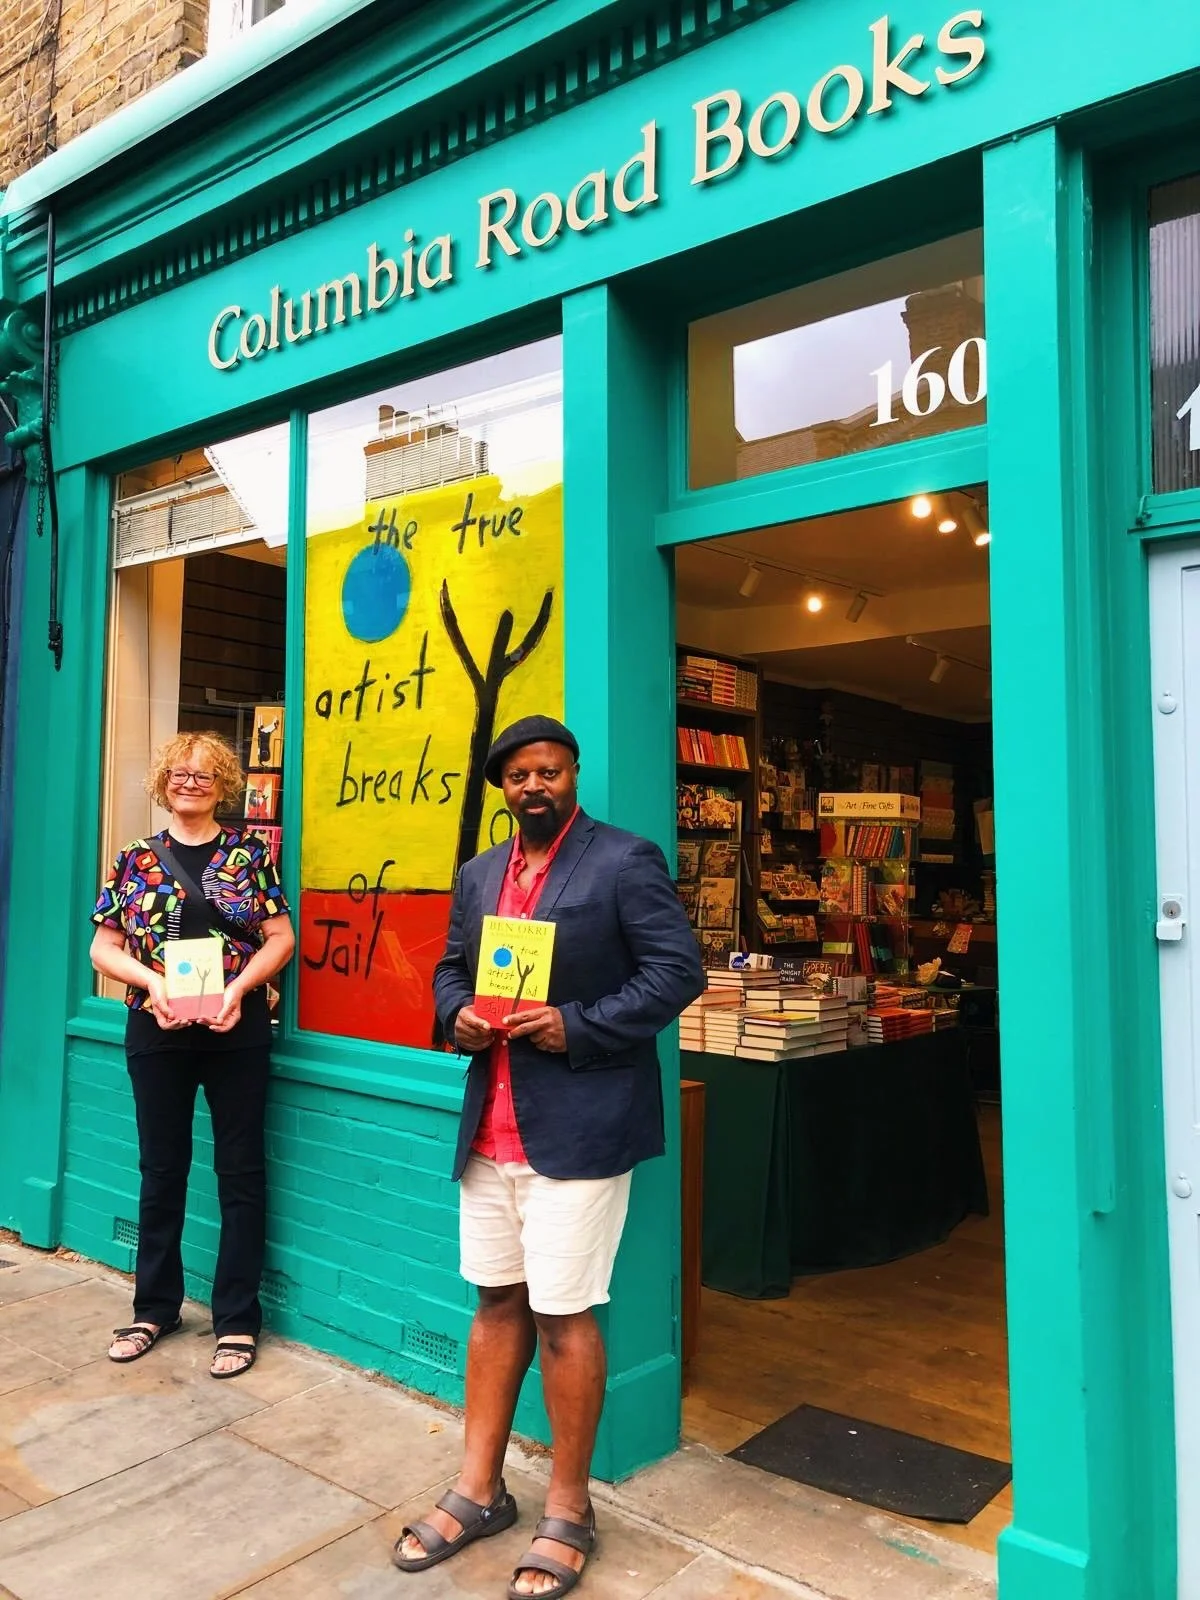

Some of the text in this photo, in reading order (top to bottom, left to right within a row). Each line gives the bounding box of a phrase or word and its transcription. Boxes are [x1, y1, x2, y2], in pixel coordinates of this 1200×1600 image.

[207, 9, 985, 371] Columbia Road Books
[869, 337, 988, 428] 160
[367, 493, 522, 554] the true
[315, 630, 435, 722] artist
[337, 734, 461, 807] breaks
[348, 860, 395, 917] of
[303, 910, 384, 984] Jail
[489, 921, 548, 936] BEN OKRI
[487, 968, 515, 980] artist
